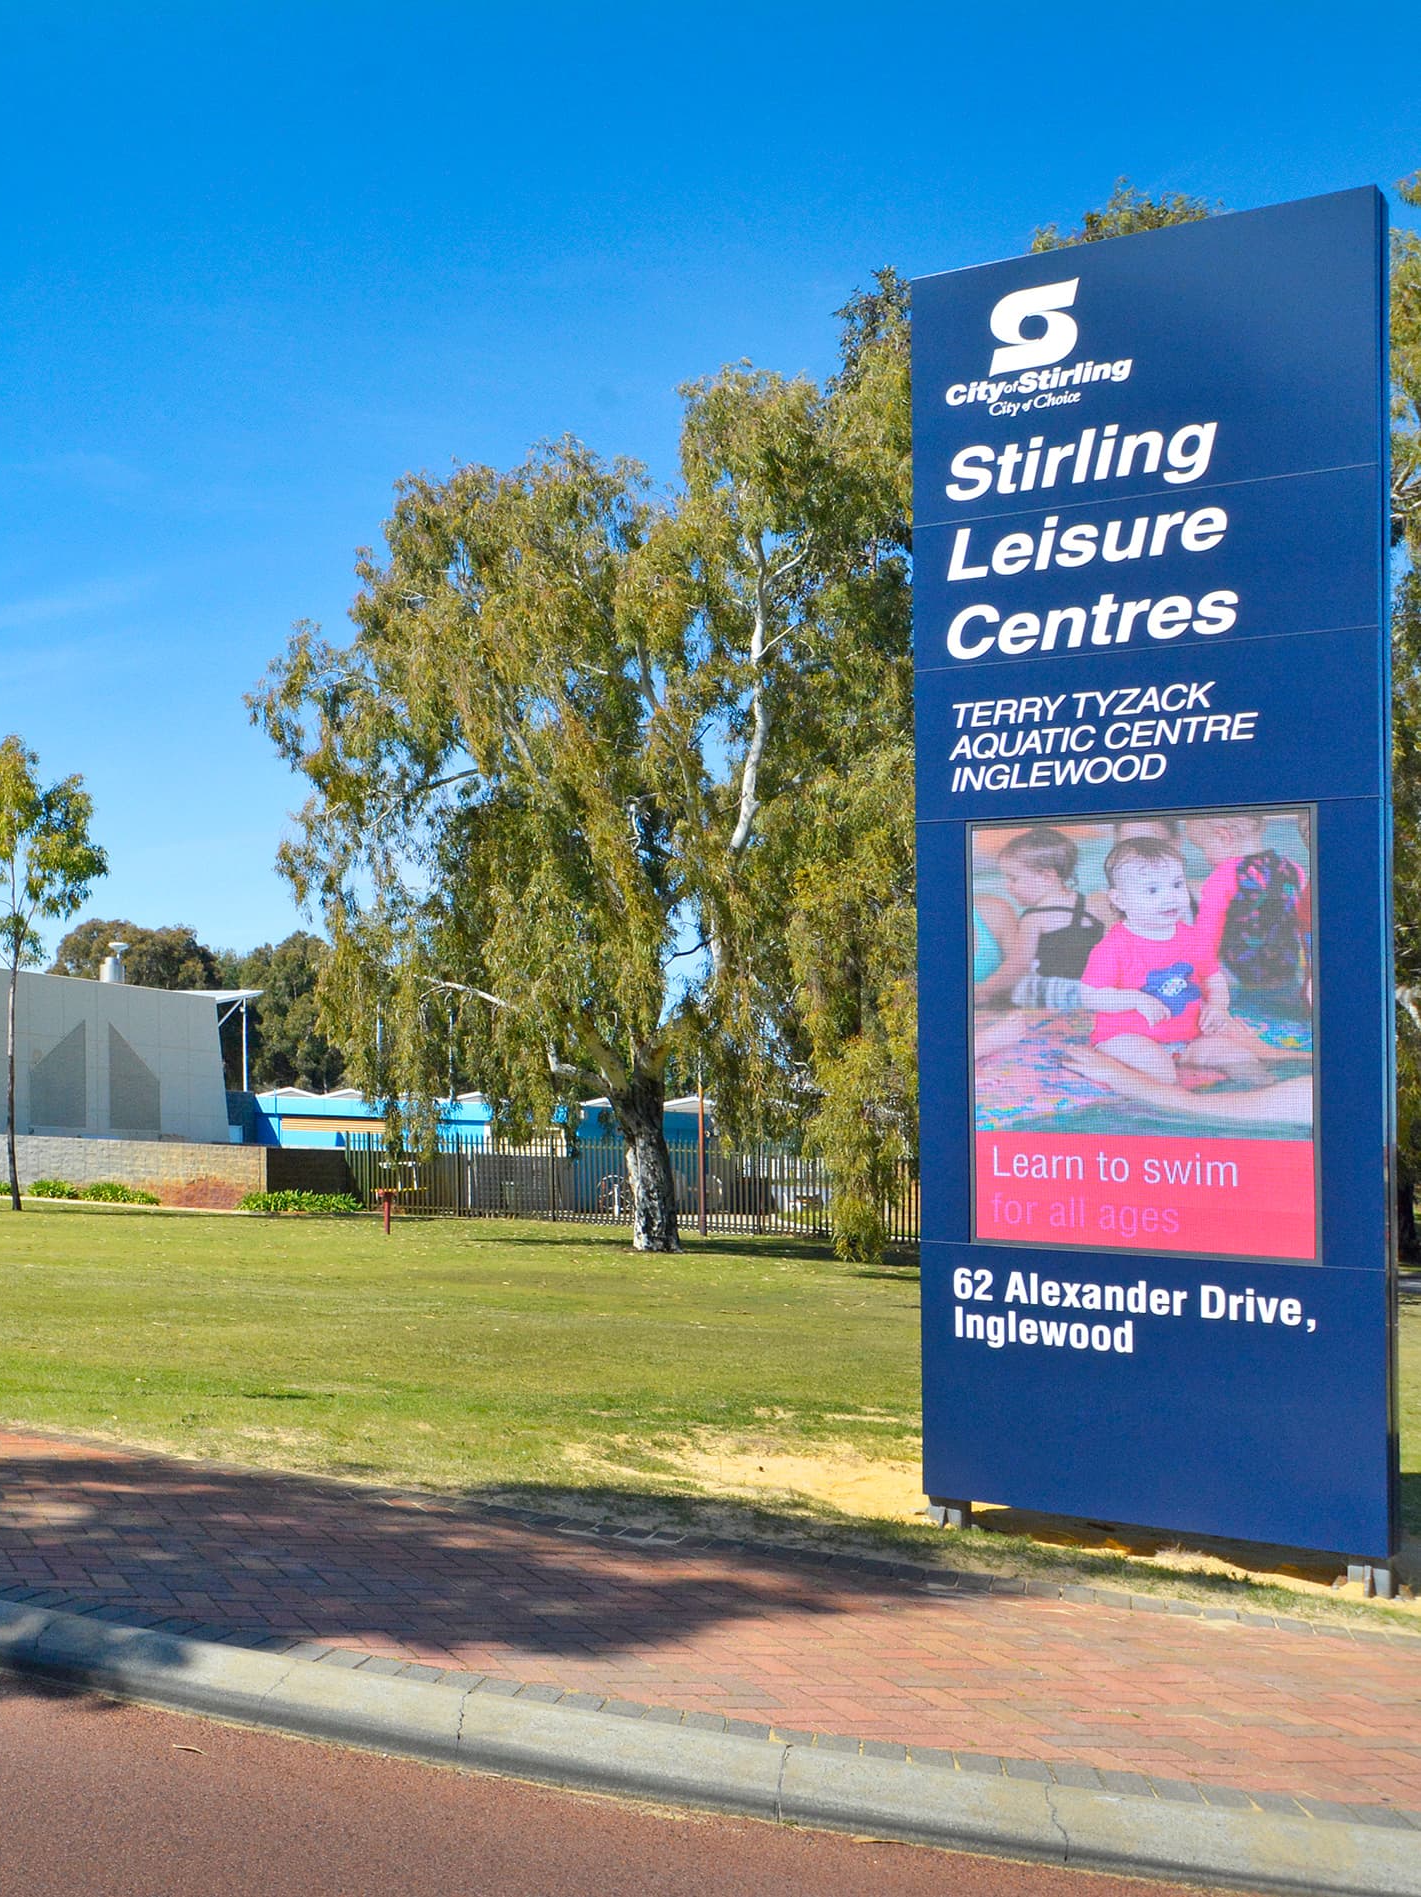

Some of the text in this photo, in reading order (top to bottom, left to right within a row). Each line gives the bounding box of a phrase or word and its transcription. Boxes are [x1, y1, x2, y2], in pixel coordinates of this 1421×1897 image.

[945, 380, 1007, 406] City
[1017, 358, 1133, 394] Stirling
[988, 391, 1082, 417] City of Choice
[945, 421, 1218, 502] Stirling
[946, 506, 1229, 582] Leisure
[946, 590, 1239, 661] Centres
[952, 681, 1216, 729] TERRY TYZACK
[949, 711, 1259, 761] AQUATIC CENTRE
[951, 753, 1168, 793] INGLEWOOD
[993, 1145, 1239, 1187] Learn to swim
[992, 1191, 1180, 1238] for all ages
[953, 1267, 1318, 1334] 62 Alexander Drive,
[954, 1306, 1134, 1353] Inglewood
